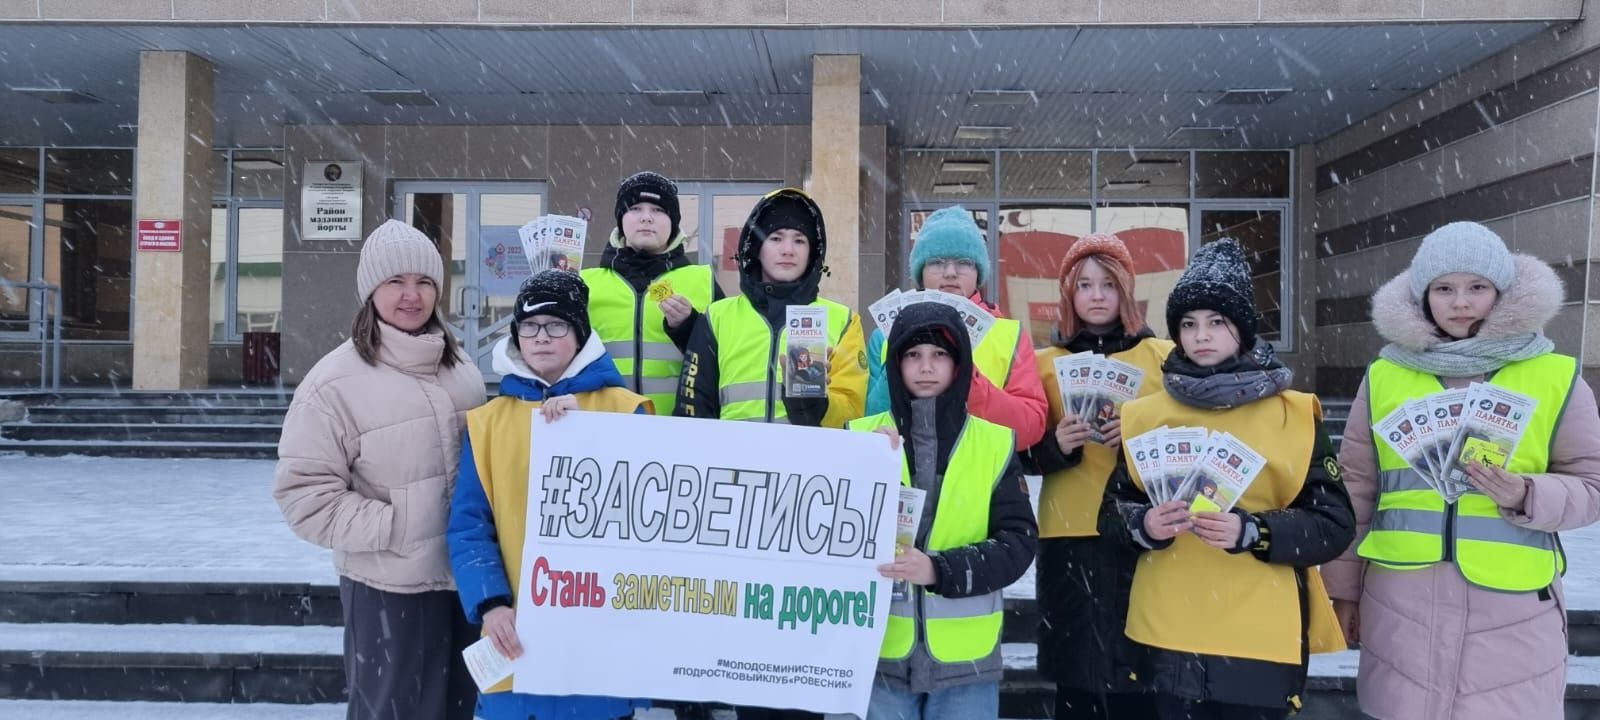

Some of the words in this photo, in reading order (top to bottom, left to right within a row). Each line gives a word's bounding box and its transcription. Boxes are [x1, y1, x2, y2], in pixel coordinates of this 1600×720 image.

[316, 207, 346, 215] Район
[317, 224, 347, 232] йорты
[1475, 409, 1518, 431] ПАМЯТКА
[539, 456, 887, 559] #ЗАСВЕТИСЬ!
[531, 556, 606, 608] Стань
[611, 573, 738, 617] заметным
[744, 582, 774, 620] на
[778, 580, 877, 635] дороге!
[672, 666, 853, 689] #ПОДРОСТКОВЫЙКЛУБ«РОВЕСНИК»
[716, 658, 854, 678] #МОЛОДОЕМИНИСТЕРСТВО
